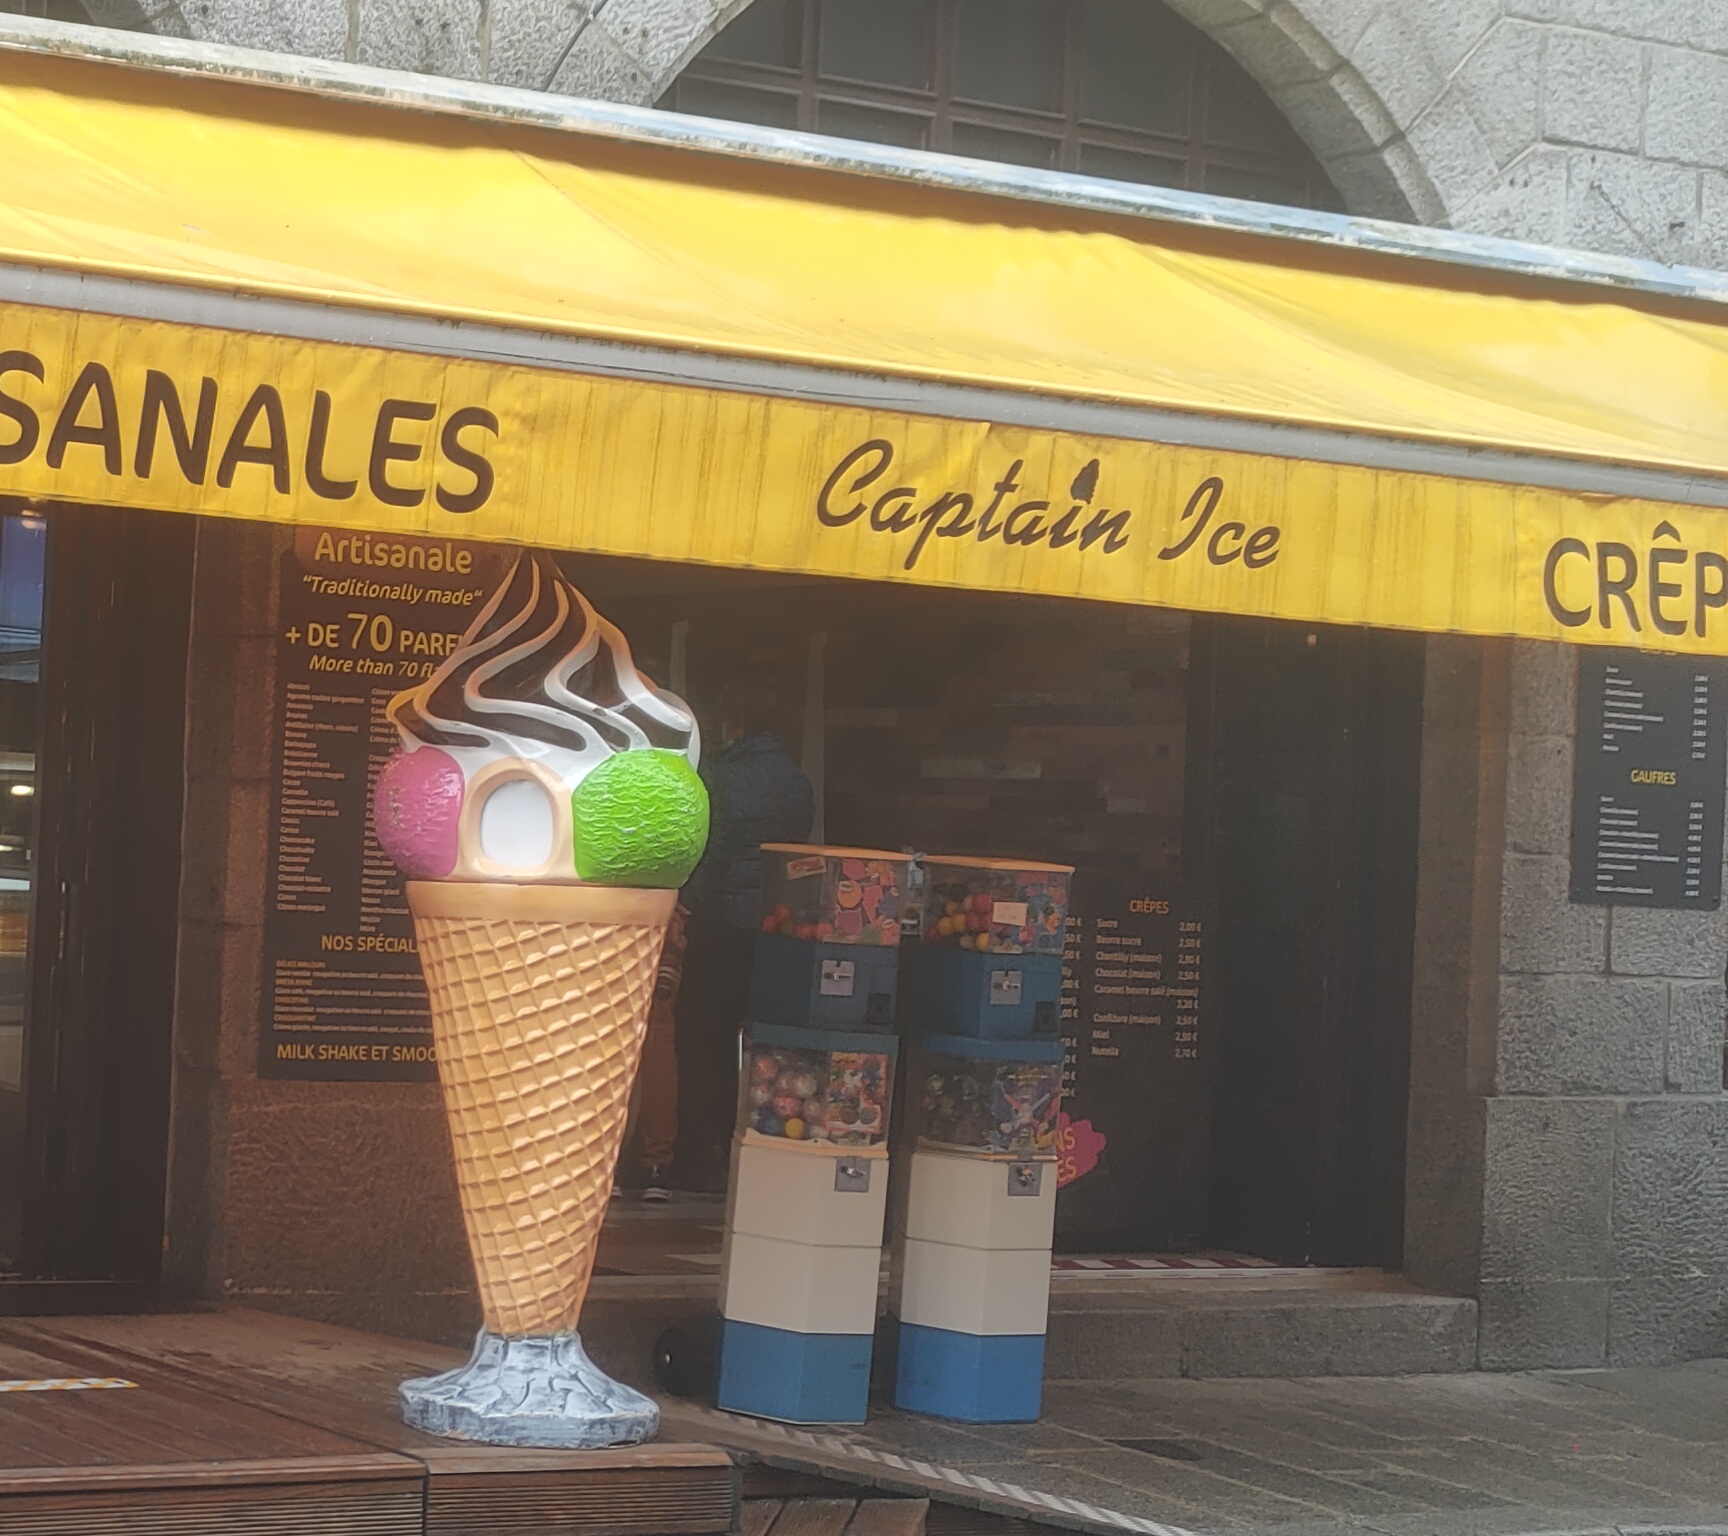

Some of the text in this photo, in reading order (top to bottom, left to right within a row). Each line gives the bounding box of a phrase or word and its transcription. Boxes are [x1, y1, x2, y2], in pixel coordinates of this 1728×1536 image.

[816, 438, 1281, 571] Captain Ice
[314, 531, 473, 574] Artisanale
[1543, 520, 1728, 638] CRÊP
[285, 625, 302, 645] +
[307, 622, 342, 648] DE
[347, 612, 393, 652] 70
[308, 654, 353, 672] More
[356, 657, 393, 676] than
[398, 660, 418, 678] 70
[1630, 769, 1677, 785] GAUFRES
[1129, 897, 1170, 914] CRÊPES
[321, 934, 354, 952] NOS
[276, 1043, 315, 1061] MILK
[318, 1043, 368, 1061] SHAKE
[371, 1045, 389, 1061] ET
